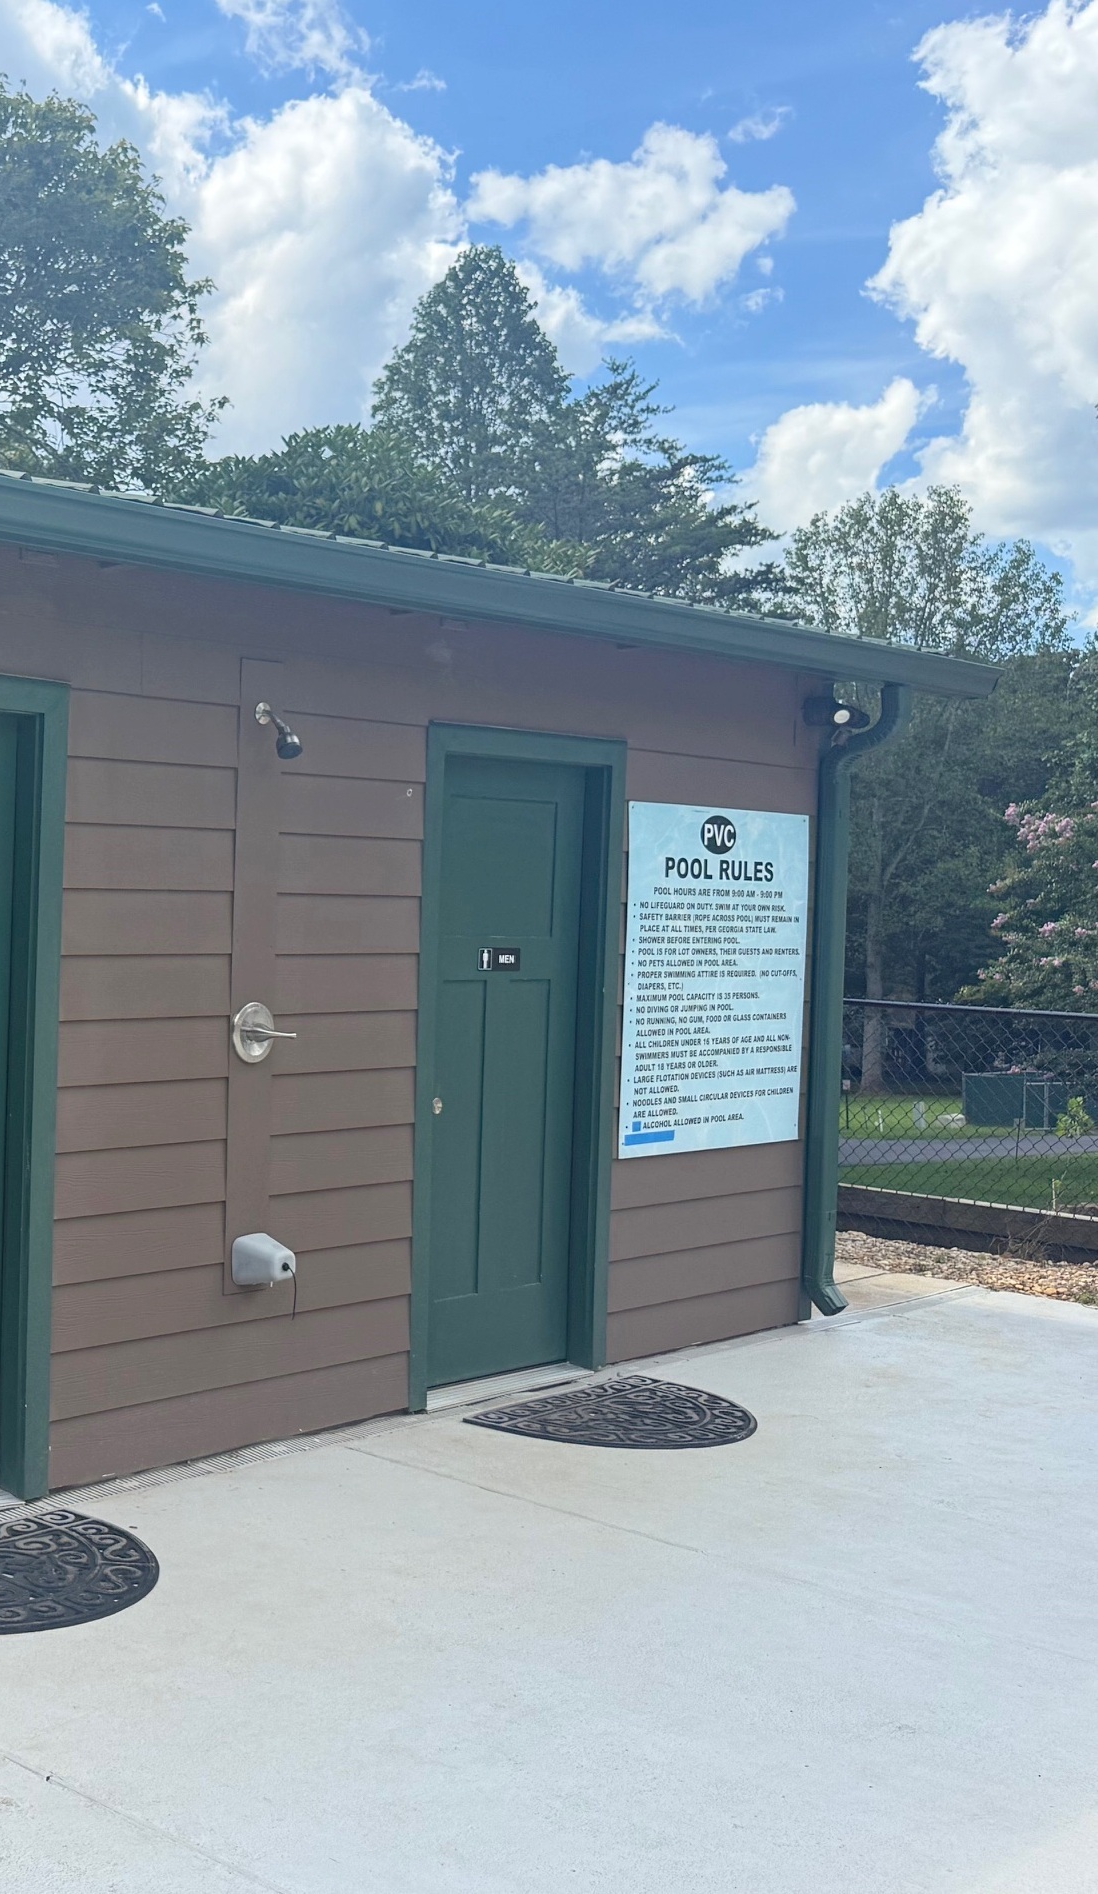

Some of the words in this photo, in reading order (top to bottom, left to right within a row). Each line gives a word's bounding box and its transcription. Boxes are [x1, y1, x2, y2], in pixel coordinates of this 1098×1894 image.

[704, 823, 735, 848] PVC
[665, 856, 713, 880] POOL
[719, 860, 774, 882] RULES
[653, 887, 671, 895] POOL
[673, 888, 696, 896] HOURS
[712, 889, 730, 897] FROM
[746, 890, 755, 898] AM
[498, 955, 514, 964] MEN
[732, 992, 760, 1000] PERSONS.
[646, 1017, 677, 1025] RUNNING,
[752, 1013, 786, 1021] CONTAINERS
[648, 1040, 679, 1048] CHILDREN
[711, 1037, 730, 1045] YEARS
[635, 1052, 669, 1060] SWIMMERS
[698, 1048, 740, 1057] ACCOMPANIED
[755, 1045, 792, 1053] RESPONSIBLE
[635, 1064, 655, 1072] ADULT
[666, 1062, 686, 1070] YEARS
[697, 1060, 718, 1068] OLDER.
[633, 1075, 654, 1083] LARGE
[655, 1073, 689, 1082] FLOTATION
[690, 1071, 715, 1079] DEVICES
[717, 1070, 735, 1078] (SUCH
[745, 1068, 754, 1076] AIR
[755, 1066, 785, 1075] MATTRESS)
[787, 1065, 797, 1073] ARE
[634, 1087, 647, 1095] NOT
[649, 1085, 679, 1094] ALLOWED.
[632, 1097, 662, 1106] NOODLES
[663, 1096, 676, 1104] AND
[678, 1094, 697, 1103] SMALL
[699, 1092, 728, 1101] CIRCULAR
[729, 1090, 753, 1099] DEVICES
[754, 1089, 765, 1097] FOR
[766, 1087, 793, 1096] CHILDREN
[633, 1110, 645, 1118] ARE
[647, 1108, 678, 1117] ALLOWED.
[643, 1120, 671, 1129] ALCOHOL
[673, 1117, 701, 1126] ALLOWED
[710, 1115, 726, 1123] POOL
[727, 1113, 744, 1121] AREA.
